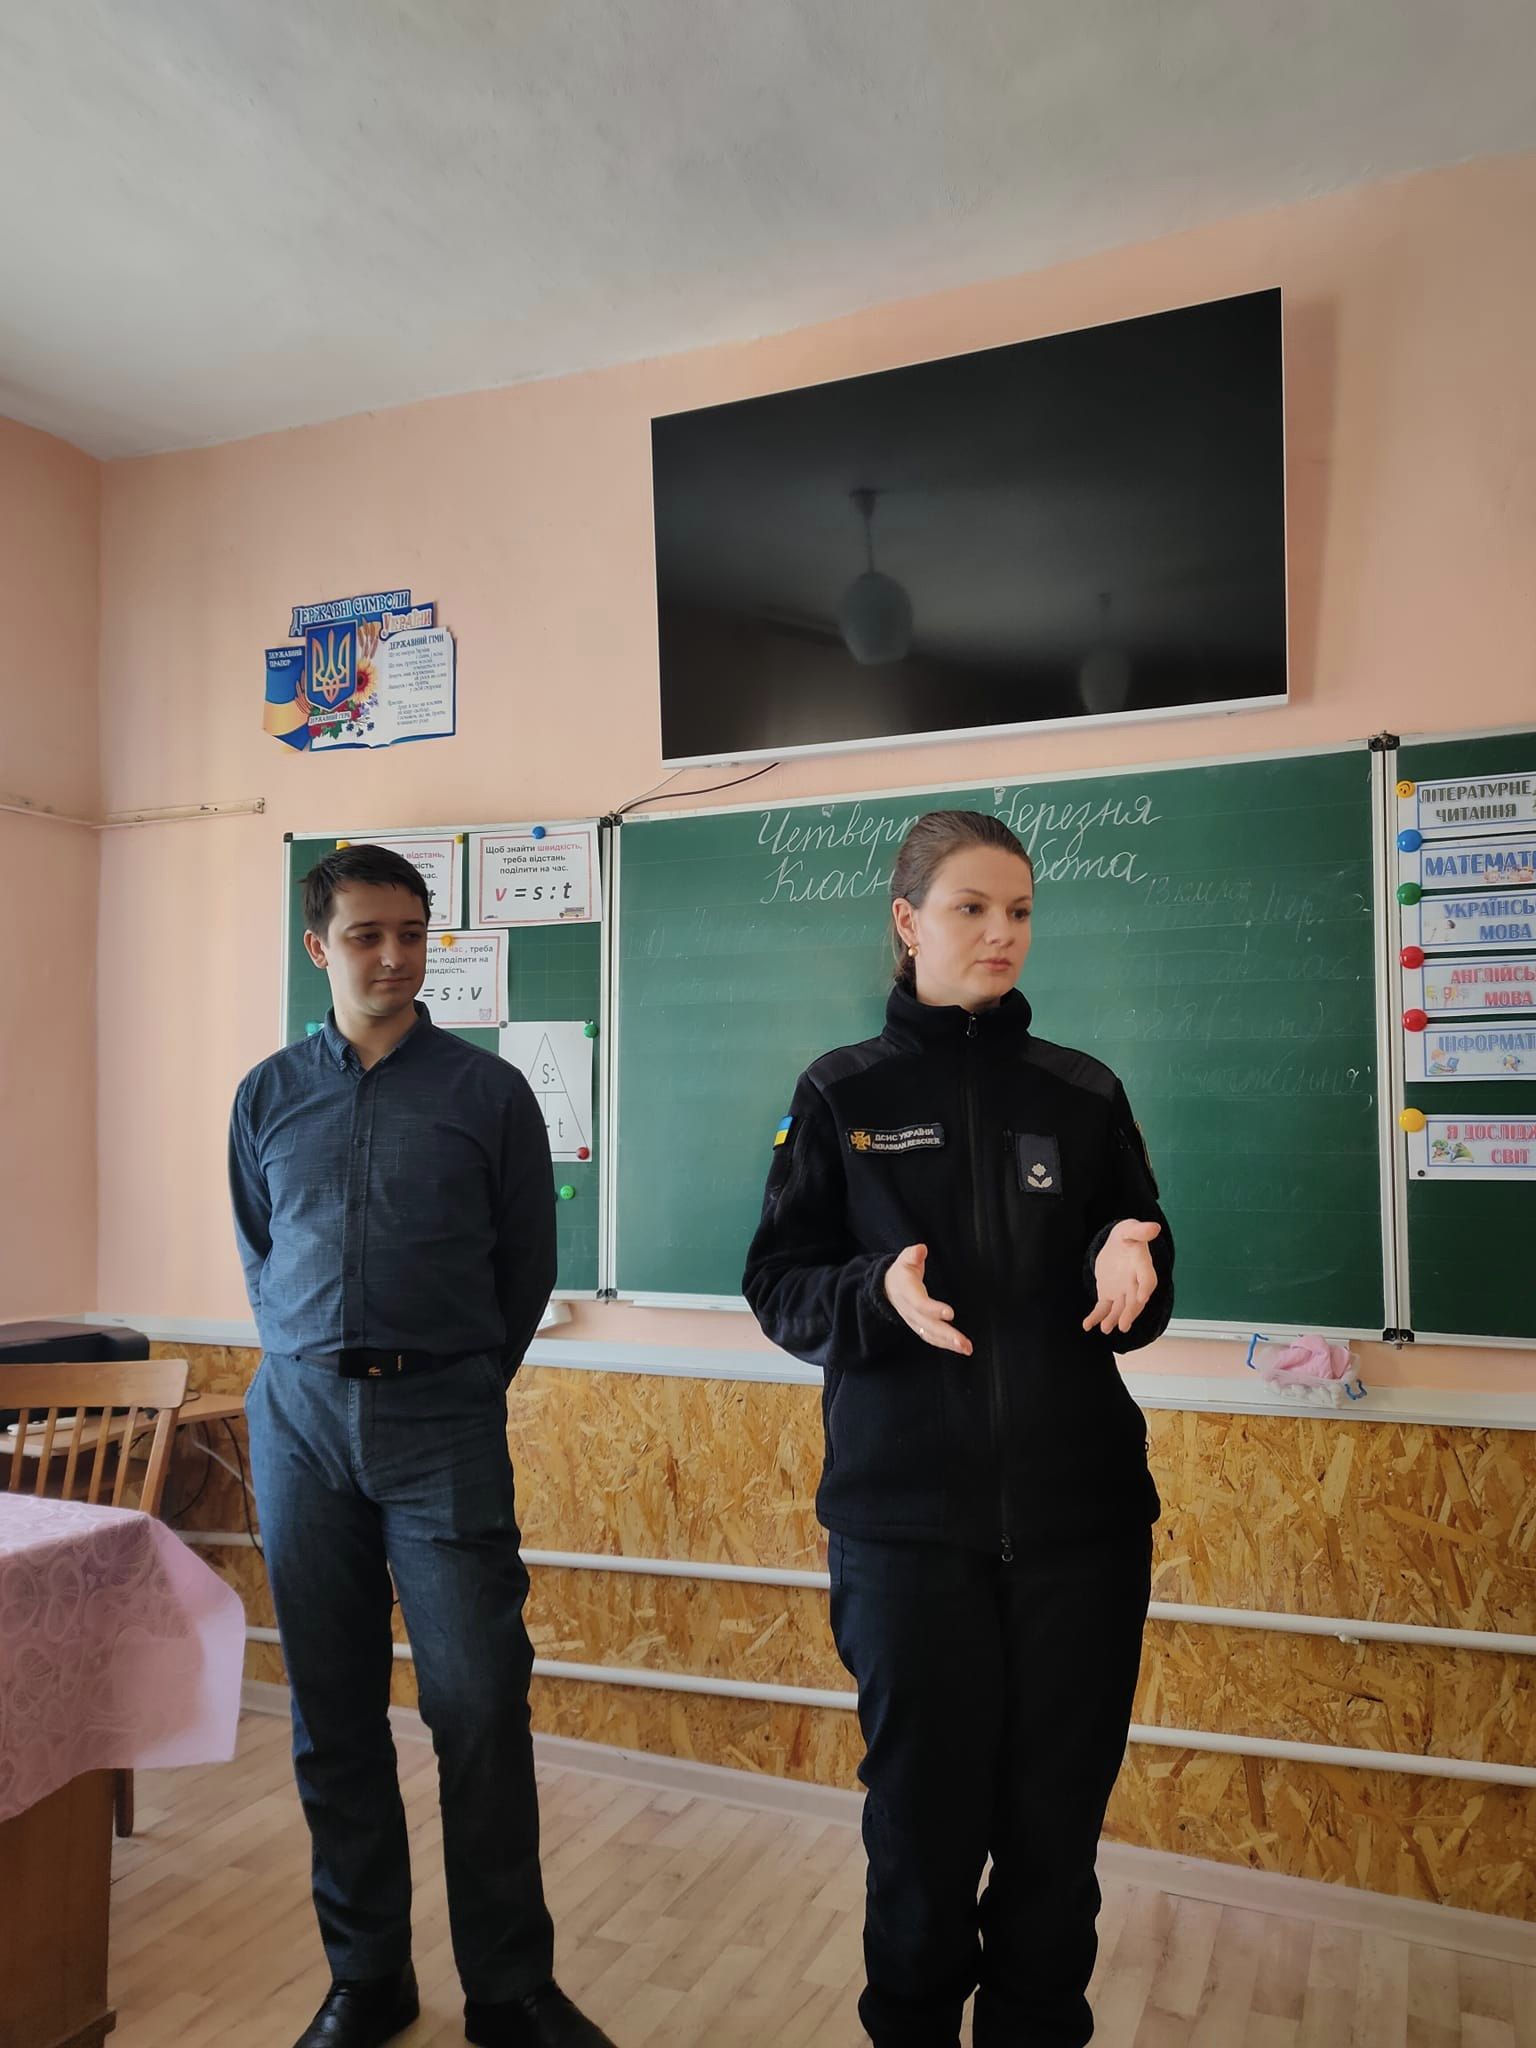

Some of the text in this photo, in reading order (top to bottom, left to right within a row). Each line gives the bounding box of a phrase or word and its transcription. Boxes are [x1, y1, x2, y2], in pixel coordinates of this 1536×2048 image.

[291, 592, 409, 635] ДЕРЖАВНІ СИМВОЛИ
[1420, 780, 1532, 804] ЛІТЕРАТУРНЕ
[1436, 803, 1518, 822] ЧИТАННЯ
[485, 845, 505, 855] Щоб
[507, 844, 536, 854] знайти
[503, 853, 566, 865] треба відстань
[500, 864, 569, 875] поділити на час.
[760, 838, 1148, 904] Класн бота
[495, 887, 507, 902] v
[563, 882, 572, 899] t
[1443, 896, 1536, 919] УКРАЇНСЬ
[1480, 923, 1532, 940] МОВА
[428, 946, 447, 954] айти
[470, 944, 494, 954] треба
[1450, 965, 1536, 984] АНГЛІЙСЬ
[1484, 989, 1533, 1007] МОВА
[1438, 1032, 1536, 1053] ІНФОРМАТ
[899, 1128, 934, 1140] УКРАЇНИ
[1446, 1124, 1459, 1140] Я
[1490, 1148, 1530, 1165] СВІТ
